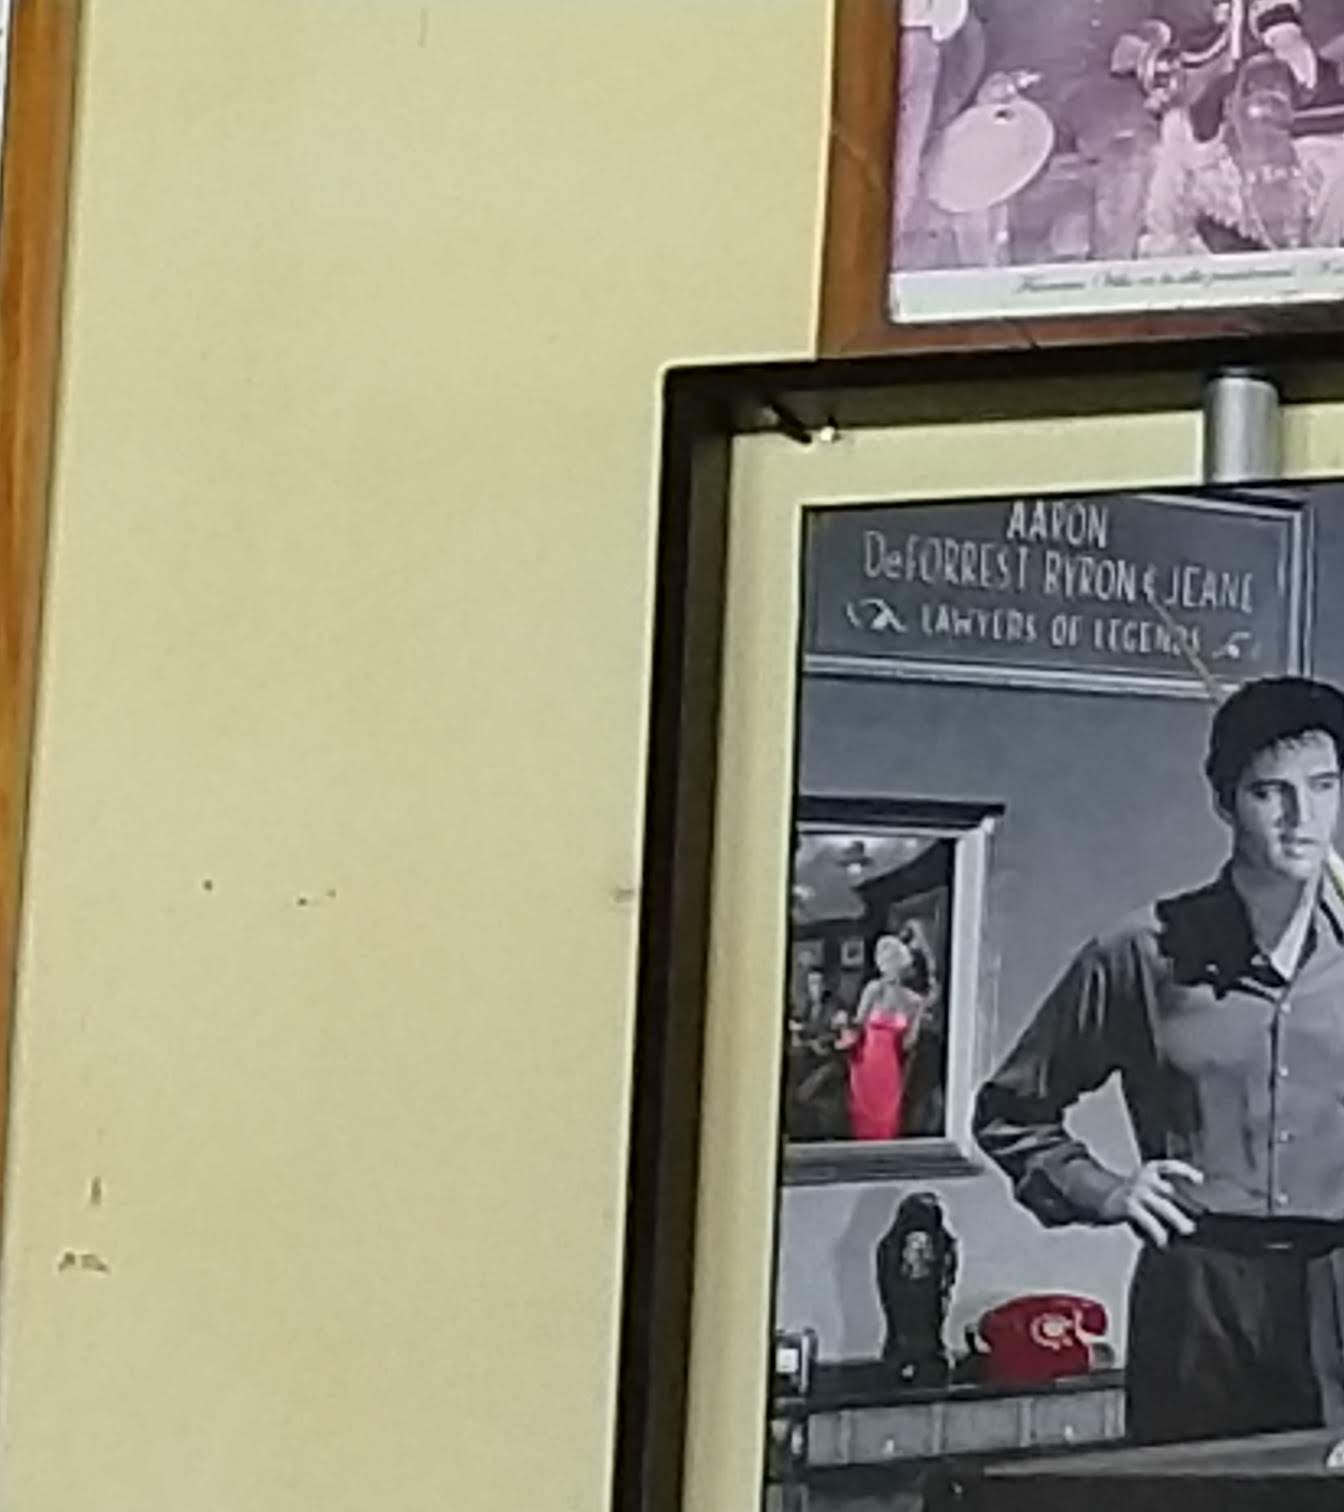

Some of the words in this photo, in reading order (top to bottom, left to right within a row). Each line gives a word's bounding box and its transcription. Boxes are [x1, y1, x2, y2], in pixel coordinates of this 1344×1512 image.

[1006, 500, 1108, 549] AARON
[863, 529, 1029, 591] DeFORREST
[1044, 549, 1137, 604] BYRON
[1163, 564, 1254, 615] JEANE
[920, 602, 1038, 645] LAWYERS
[1051, 613, 1083, 647] OF
